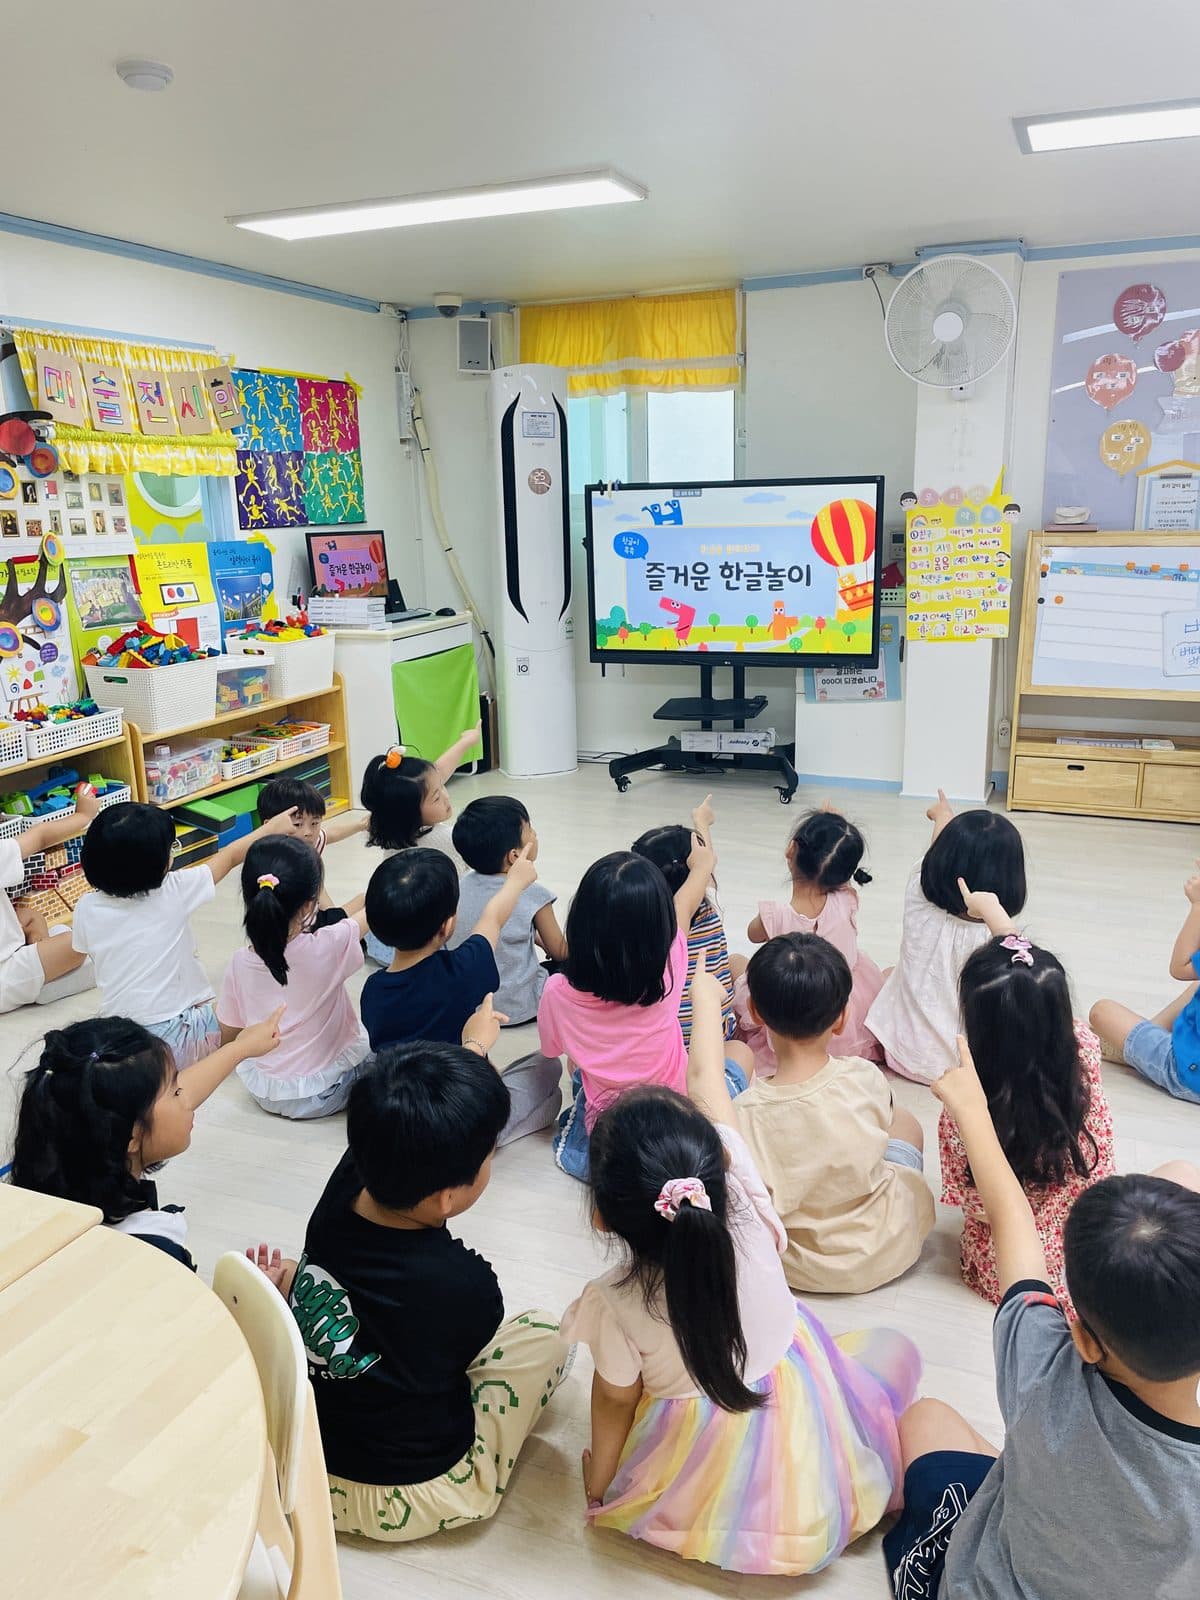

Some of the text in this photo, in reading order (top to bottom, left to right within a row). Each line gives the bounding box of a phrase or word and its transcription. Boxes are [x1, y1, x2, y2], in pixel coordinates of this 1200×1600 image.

[328, 561, 373, 577] 즐거운 한글놀이
[645, 561, 811, 592] 즐거운 한글놀이
[843, 675, 877, 685] 되겠습니다
